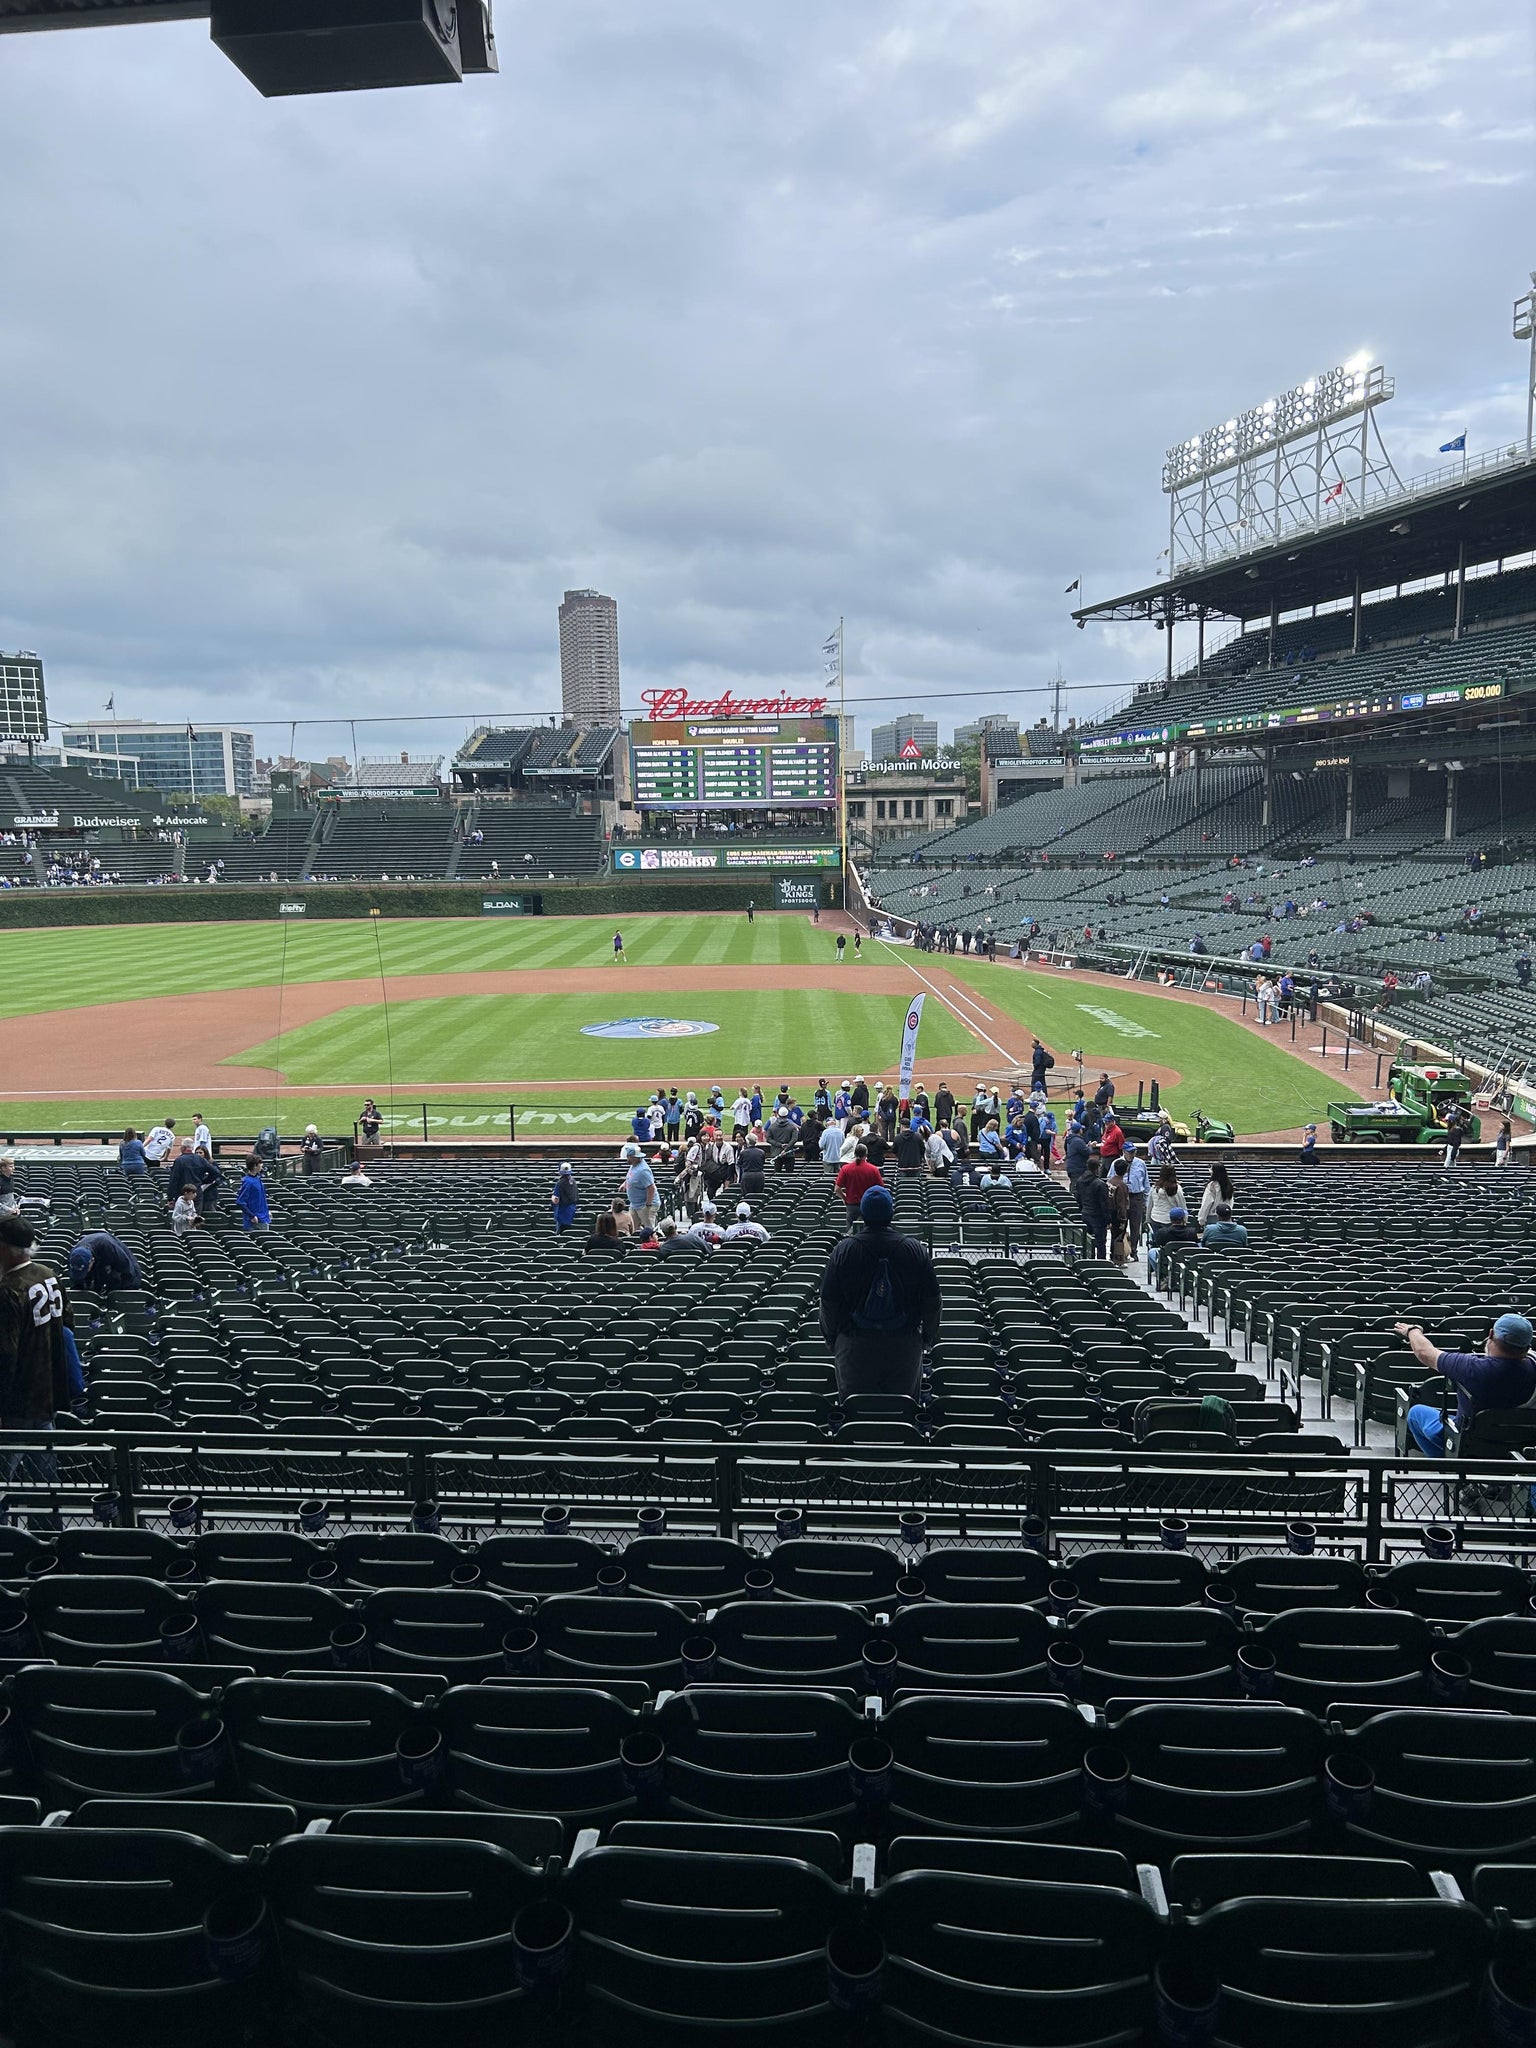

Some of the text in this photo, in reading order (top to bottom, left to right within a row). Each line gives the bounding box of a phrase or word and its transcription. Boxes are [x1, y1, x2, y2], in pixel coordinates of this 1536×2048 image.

[1464, 684, 1501, 700] $200,000
[641, 688, 827, 719] Budweiser
[860, 759, 960, 773] Benjamin Moore
[166, 816, 208, 825] Advocate
[661, 856, 717, 867] HORNSBY
[781, 884, 814, 892] DRAFT
[374, 1109, 642, 1129] Southwe
[157, 1136, 167, 1144] 2
[28, 1277, 63, 1327] 25
